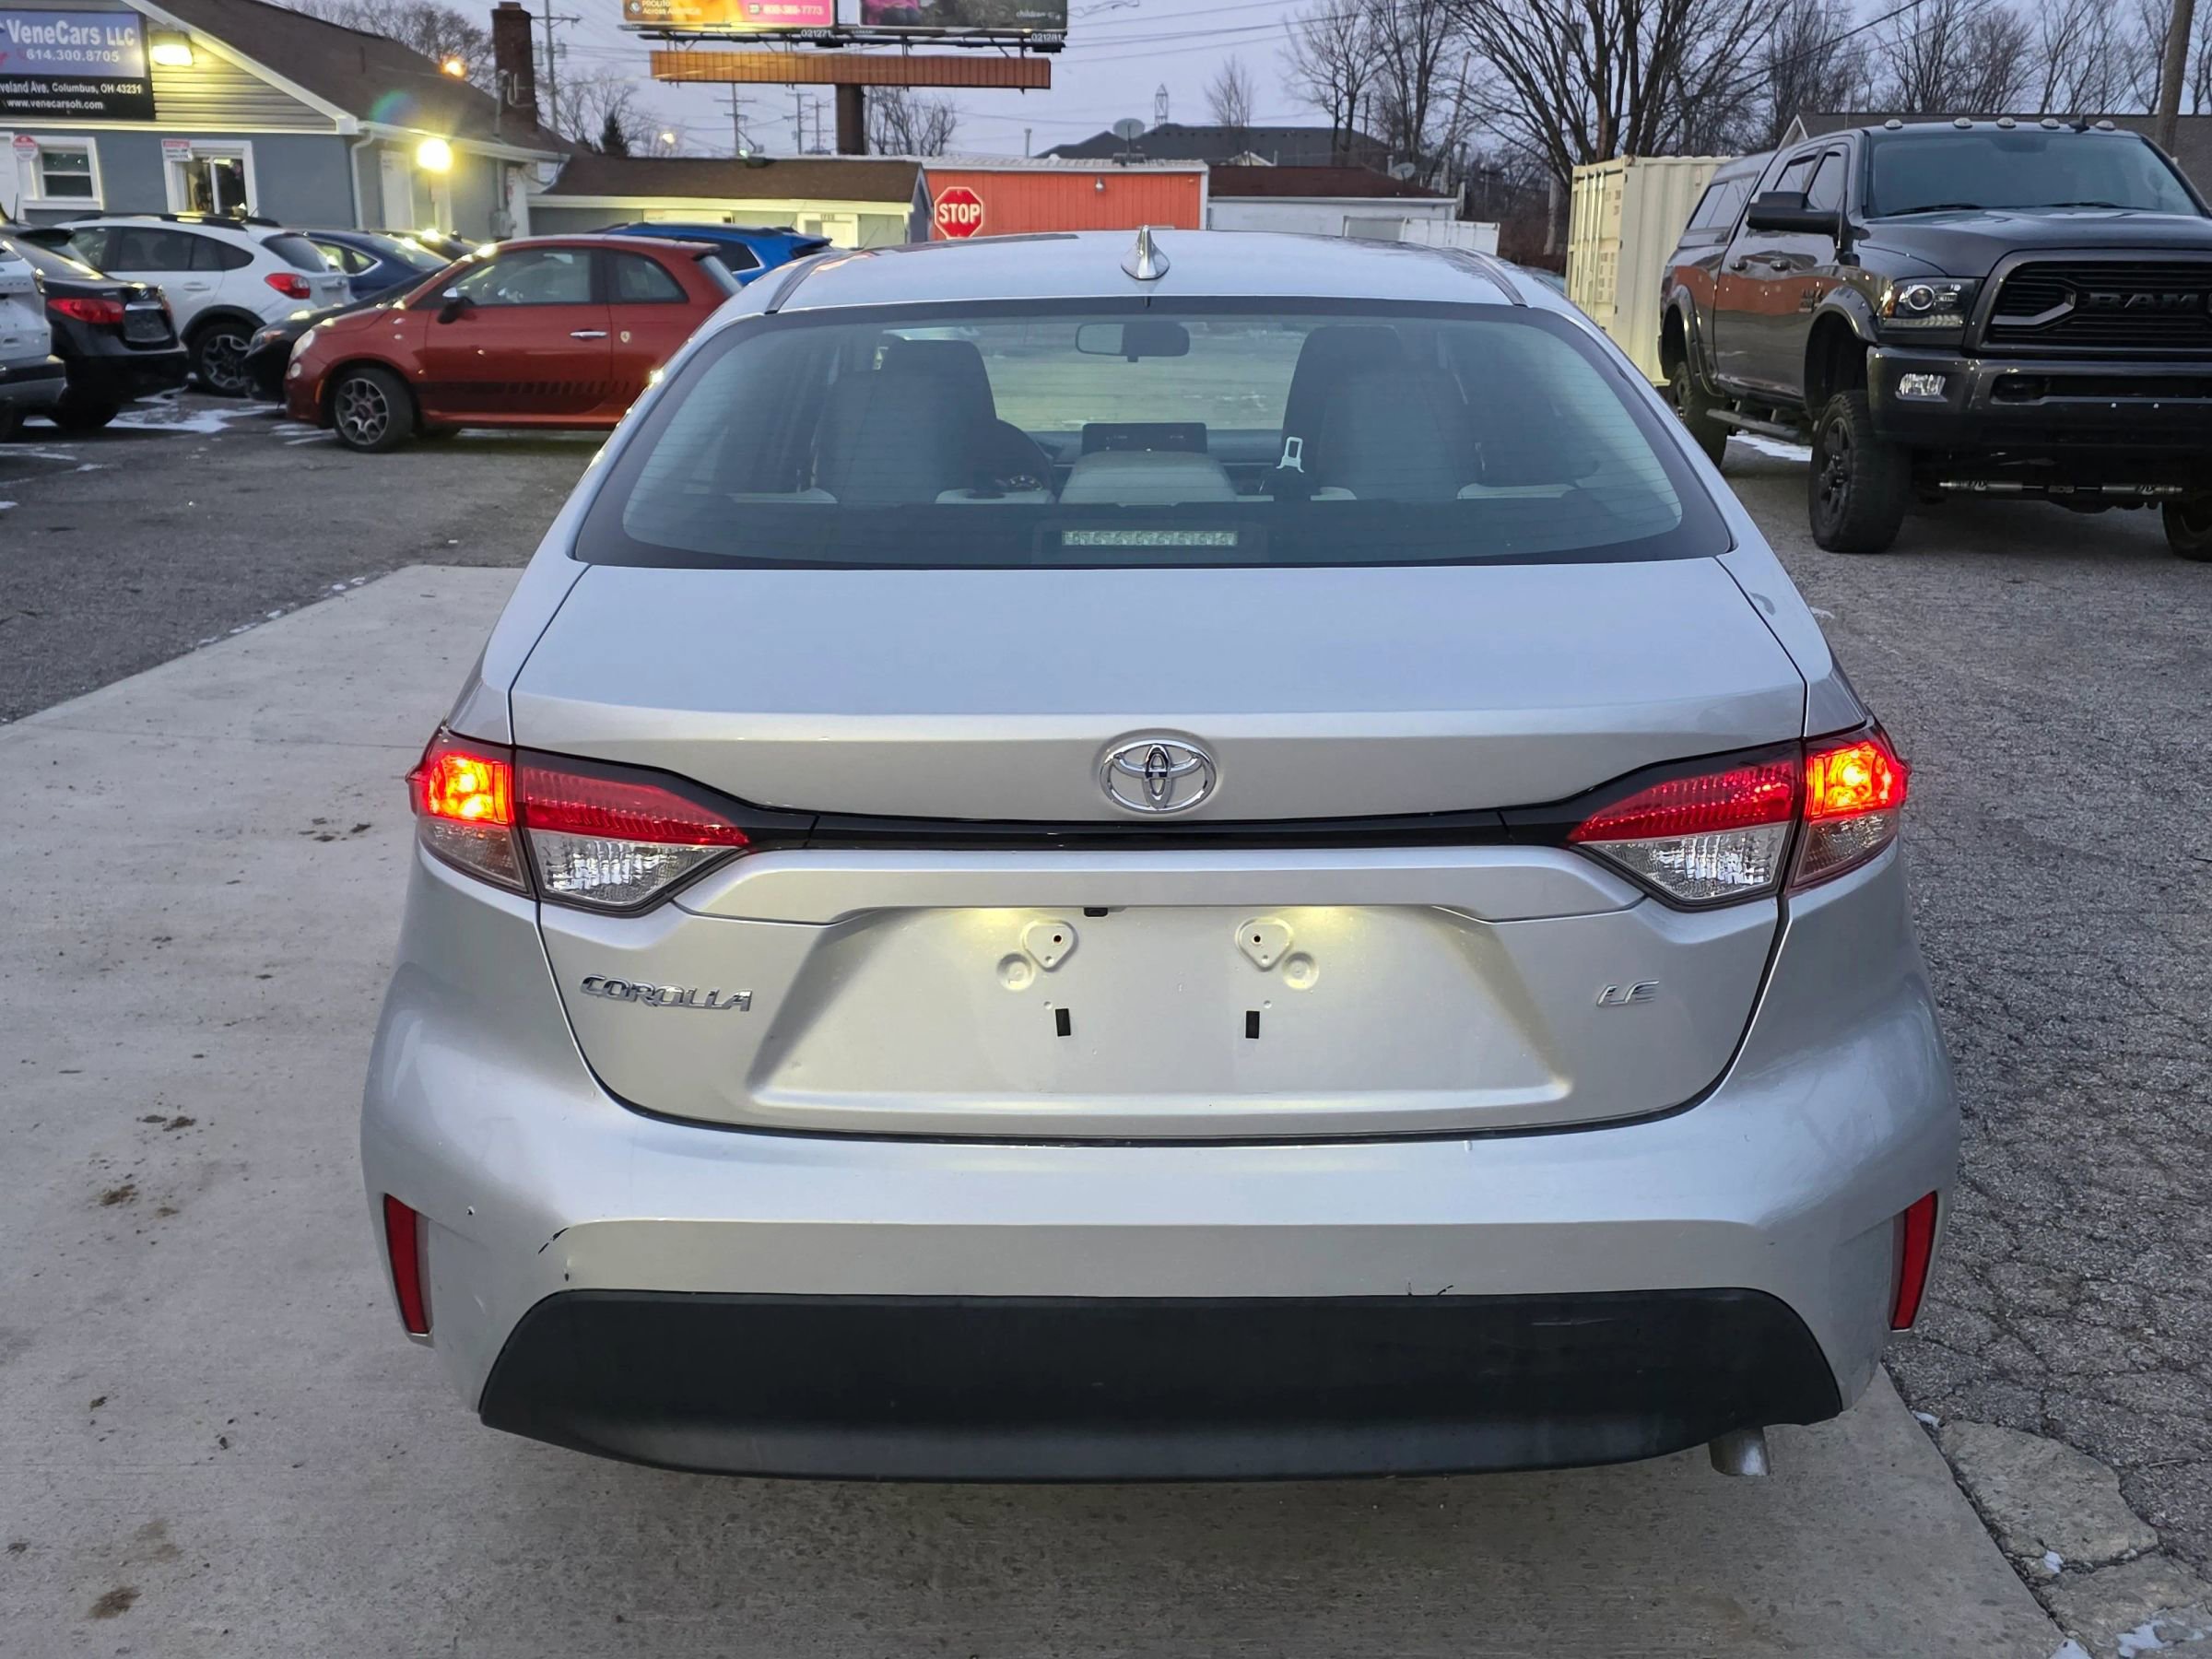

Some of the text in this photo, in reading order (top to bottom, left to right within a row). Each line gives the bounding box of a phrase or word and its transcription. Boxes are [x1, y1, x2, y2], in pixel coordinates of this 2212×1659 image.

[6, 18, 135, 45] VeneCars LLC
[26, 48, 121, 63] 614.300.8705
[52, 82, 99, 95] Columbus,
[100, 83, 115, 94] OH
[6, 99, 104, 111] www.venecarsoh.com
[939, 203, 981, 224] STOP
[2088, 291, 2200, 312] RAM
[580, 973, 753, 1013] COROLLA
[1595, 980, 1660, 1007] LE
